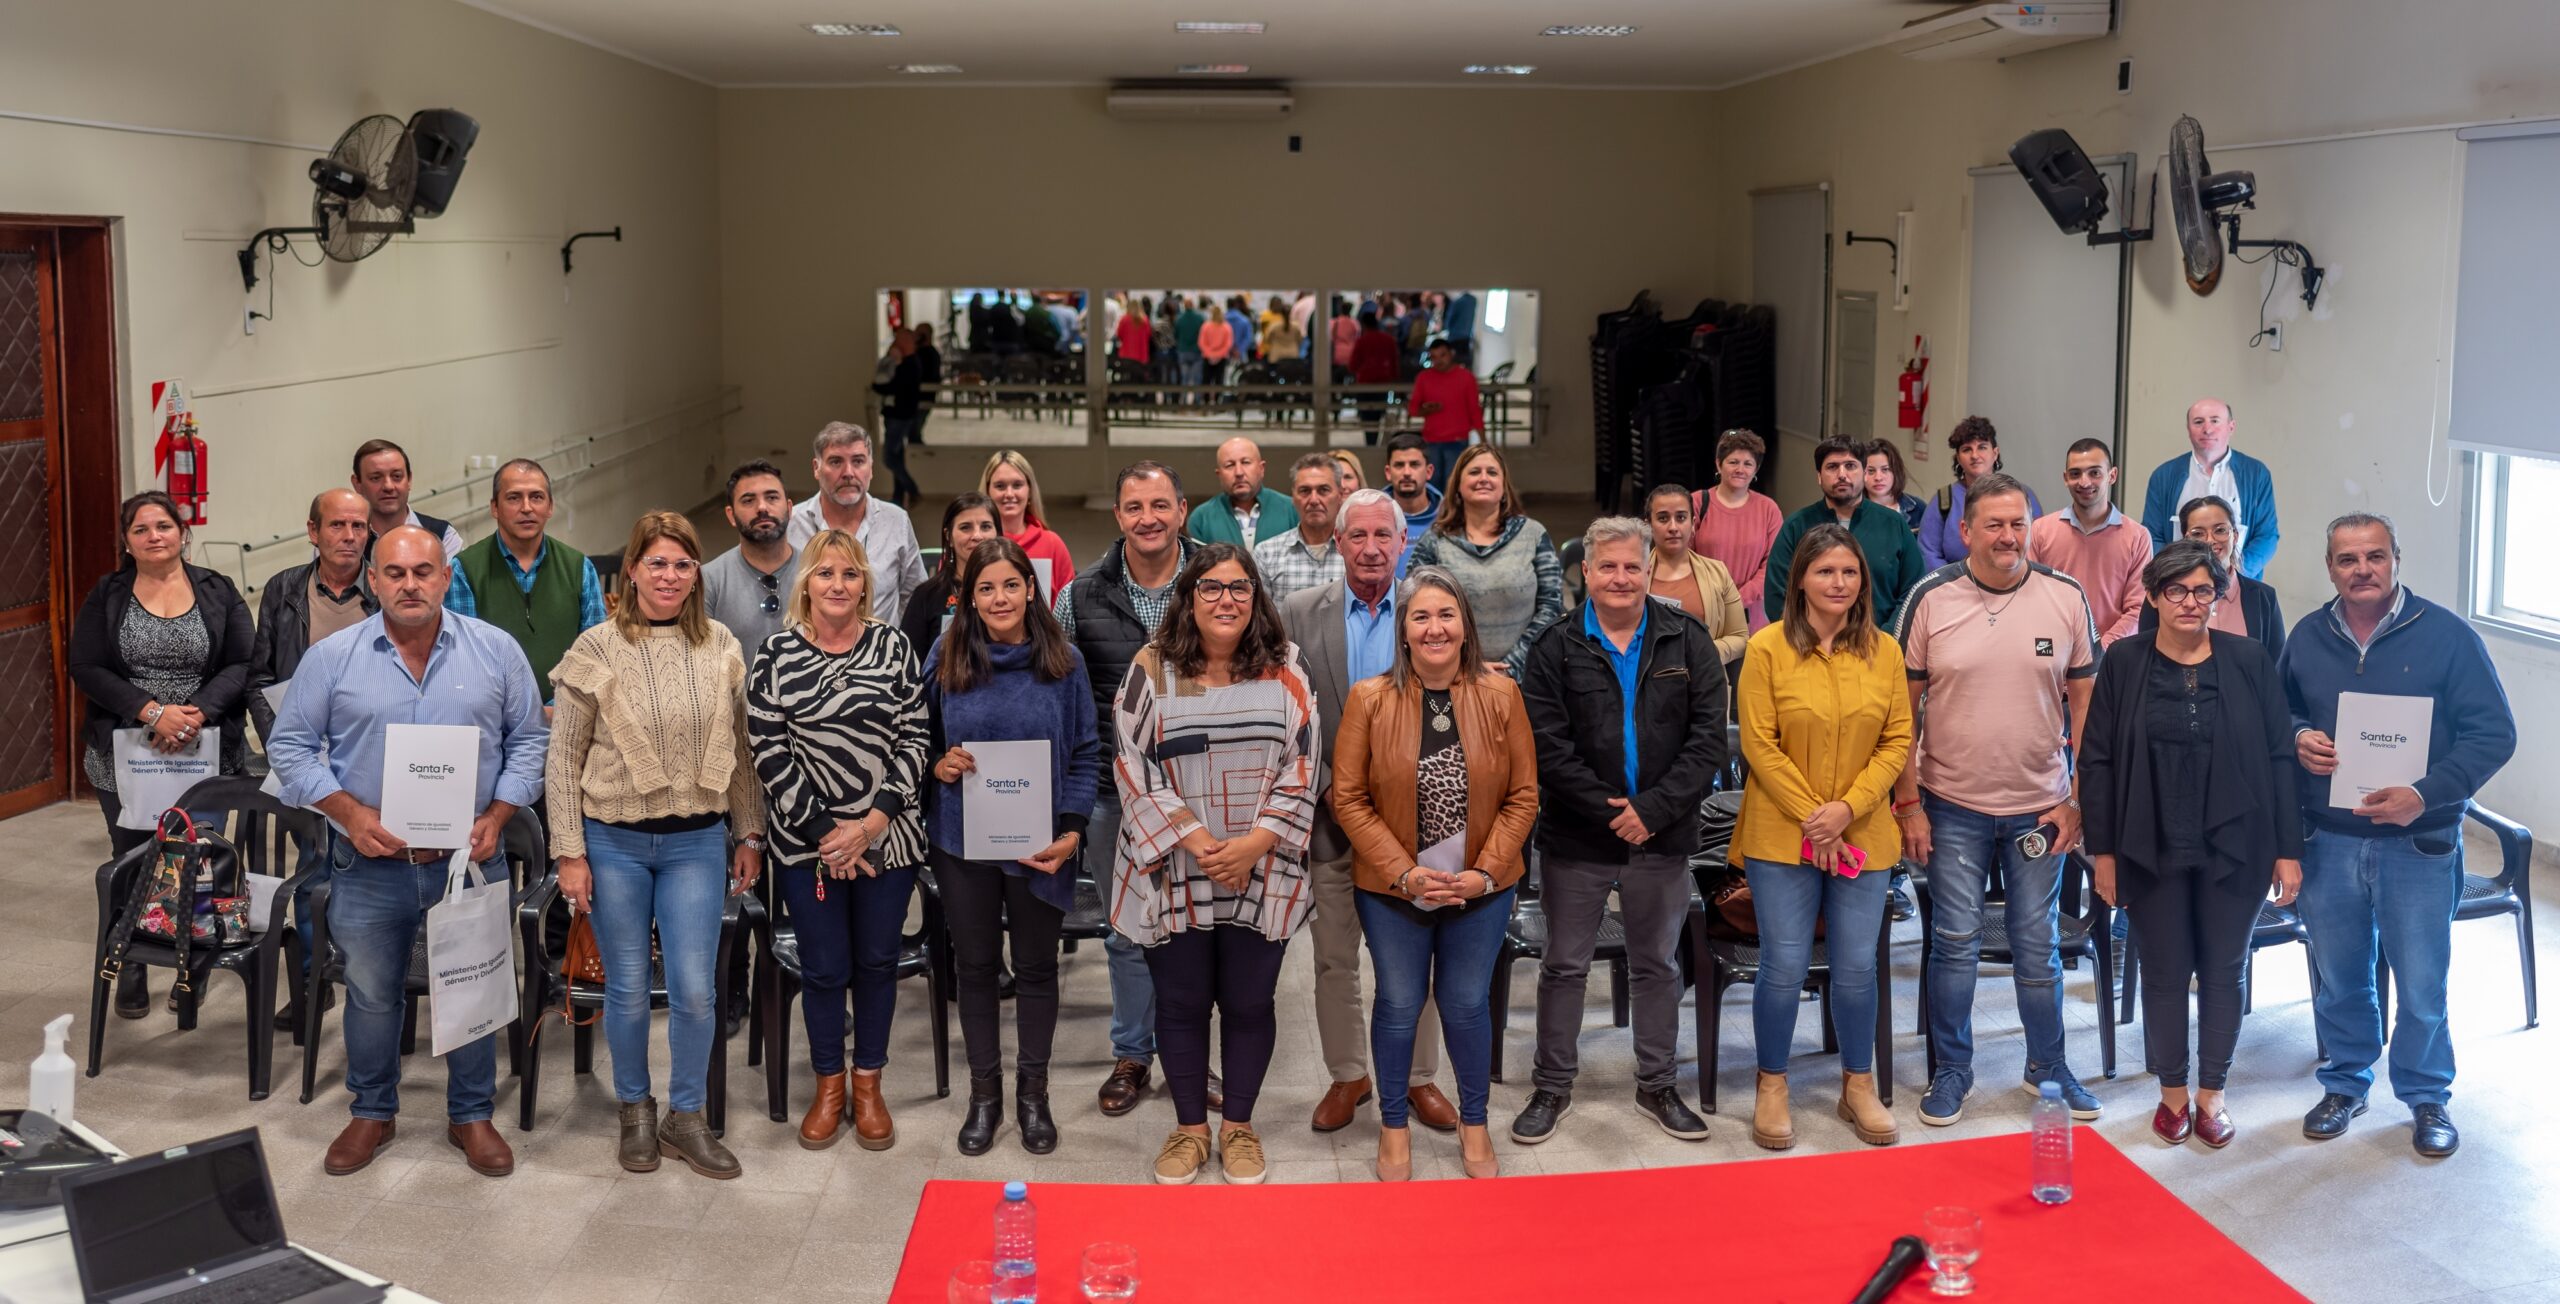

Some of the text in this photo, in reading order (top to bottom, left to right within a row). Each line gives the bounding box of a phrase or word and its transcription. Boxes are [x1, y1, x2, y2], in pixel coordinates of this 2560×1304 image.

[2360, 731, 2407, 743] Santa Fe
[131, 766, 159, 774] Género
[408, 763, 455, 774] Santa Fe
[986, 778, 1030, 788] Santa Fe
[439, 964, 478, 978] Ministerio
[478, 961, 488, 969] de
[444, 974, 473, 986] Género
[474, 973, 479, 981] y
[468, 1022, 486, 1033] Santa
